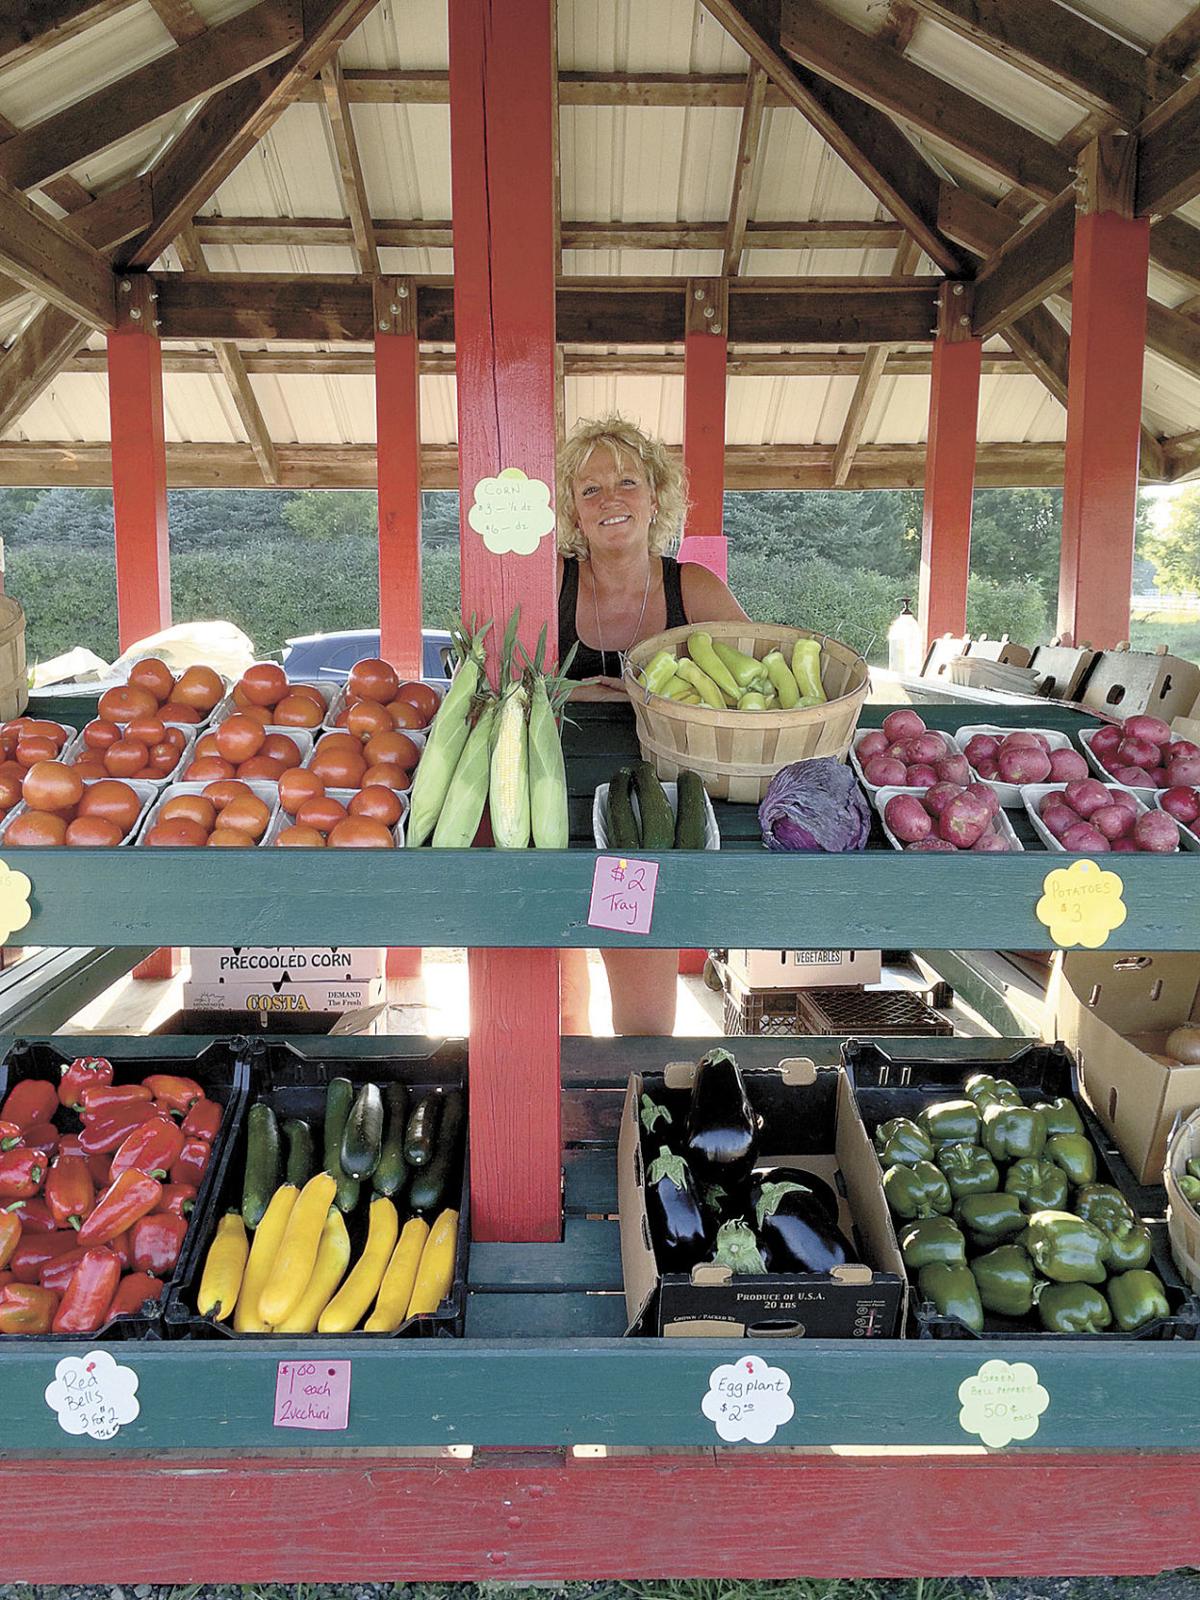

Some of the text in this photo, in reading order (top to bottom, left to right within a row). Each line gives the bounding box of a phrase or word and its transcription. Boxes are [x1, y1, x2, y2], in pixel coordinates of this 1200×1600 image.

[1052, 879, 1111, 899] POTATOES
[602, 892, 638, 925] Tray
[220, 953, 352, 970] PRECOOLED CORN
[796, 950, 840, 963] VEGETABLES
[246, 994, 310, 1011] COSTA
[736, 1292, 826, 1301] PRODUCE OF U.S.A.
[764, 1301, 777, 1309] 20
[63, 1370, 98, 1392] Red
[304, 1381, 331, 1397] each
[64, 1390, 104, 1411] Bells
[80, 1413, 89, 1428] 3
